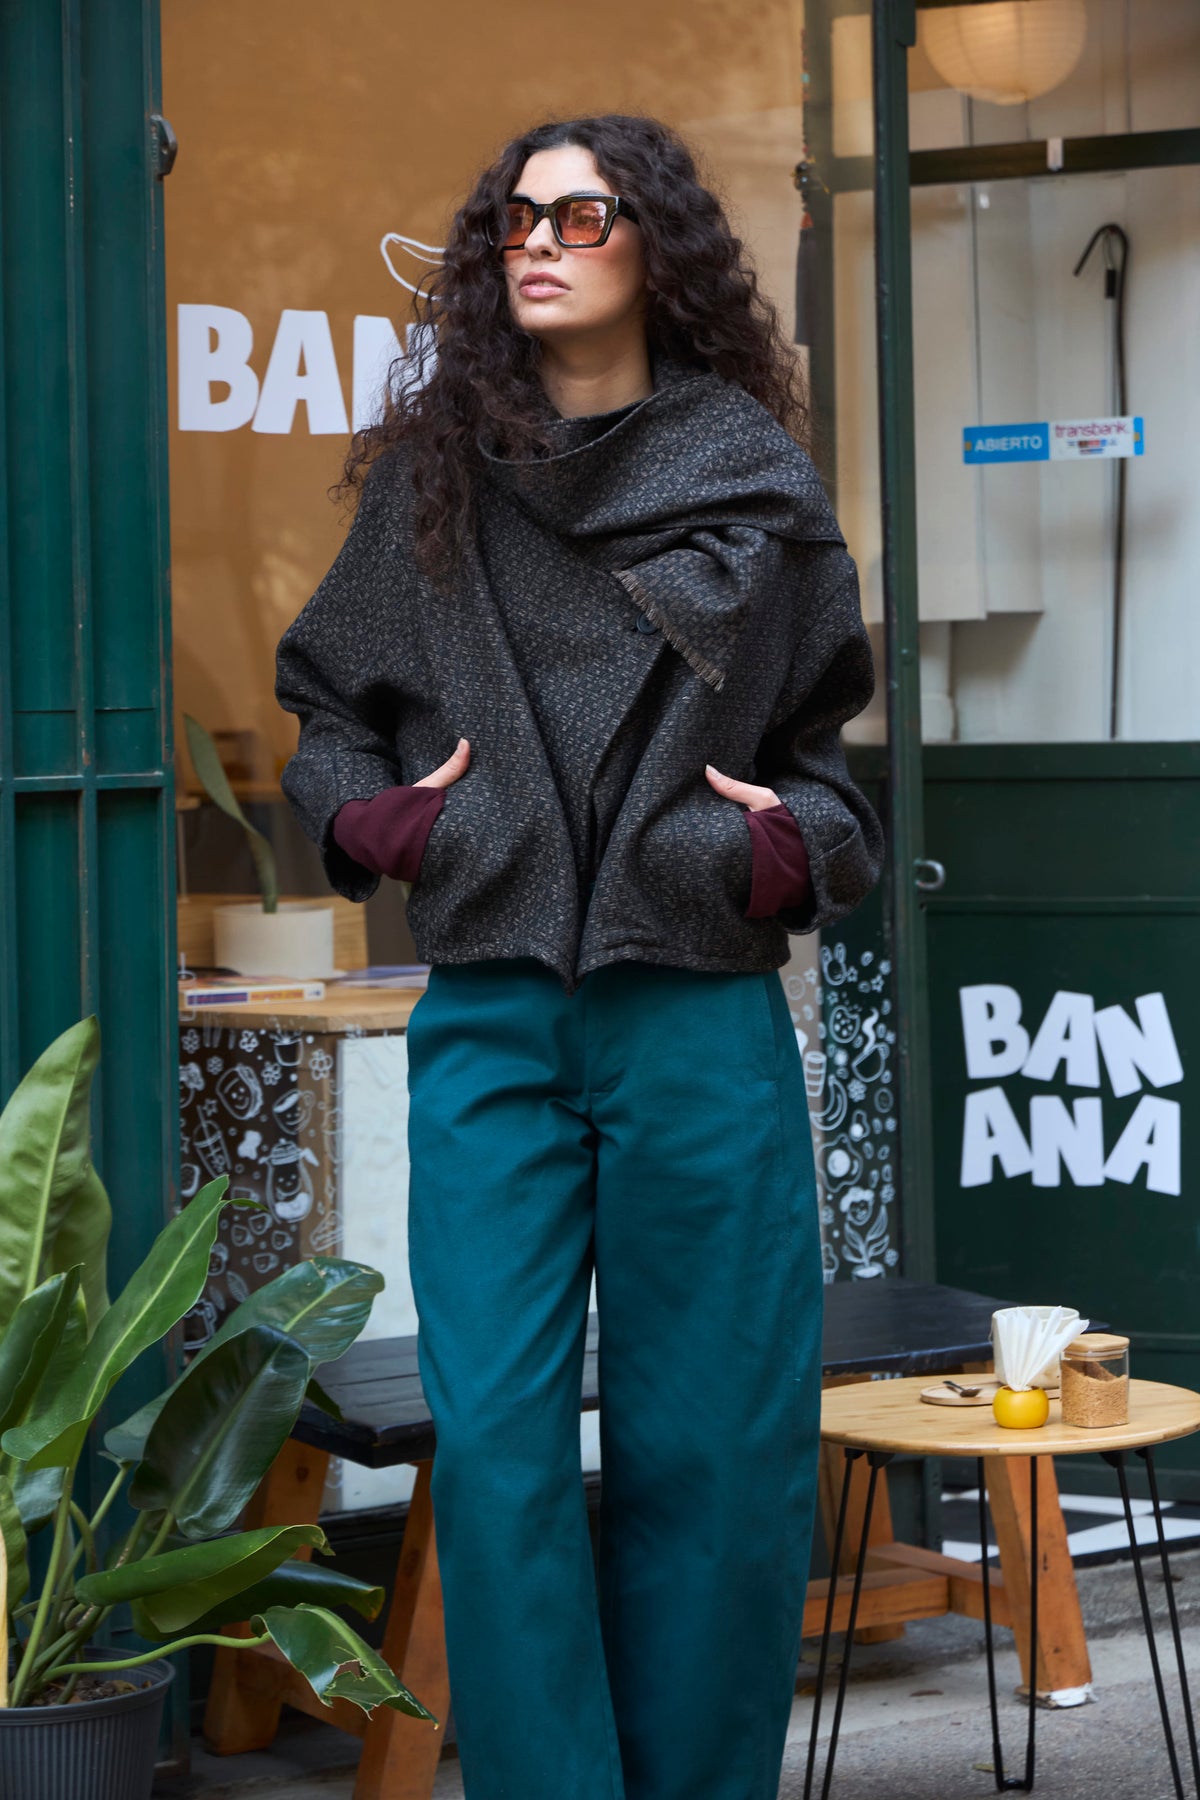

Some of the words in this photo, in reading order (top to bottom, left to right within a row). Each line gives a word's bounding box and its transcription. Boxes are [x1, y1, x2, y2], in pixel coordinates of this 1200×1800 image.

[974, 434, 1043, 453] ABIERTO
[960, 984, 1184, 1098] BAN
[960, 1086, 1181, 1196] ANA
